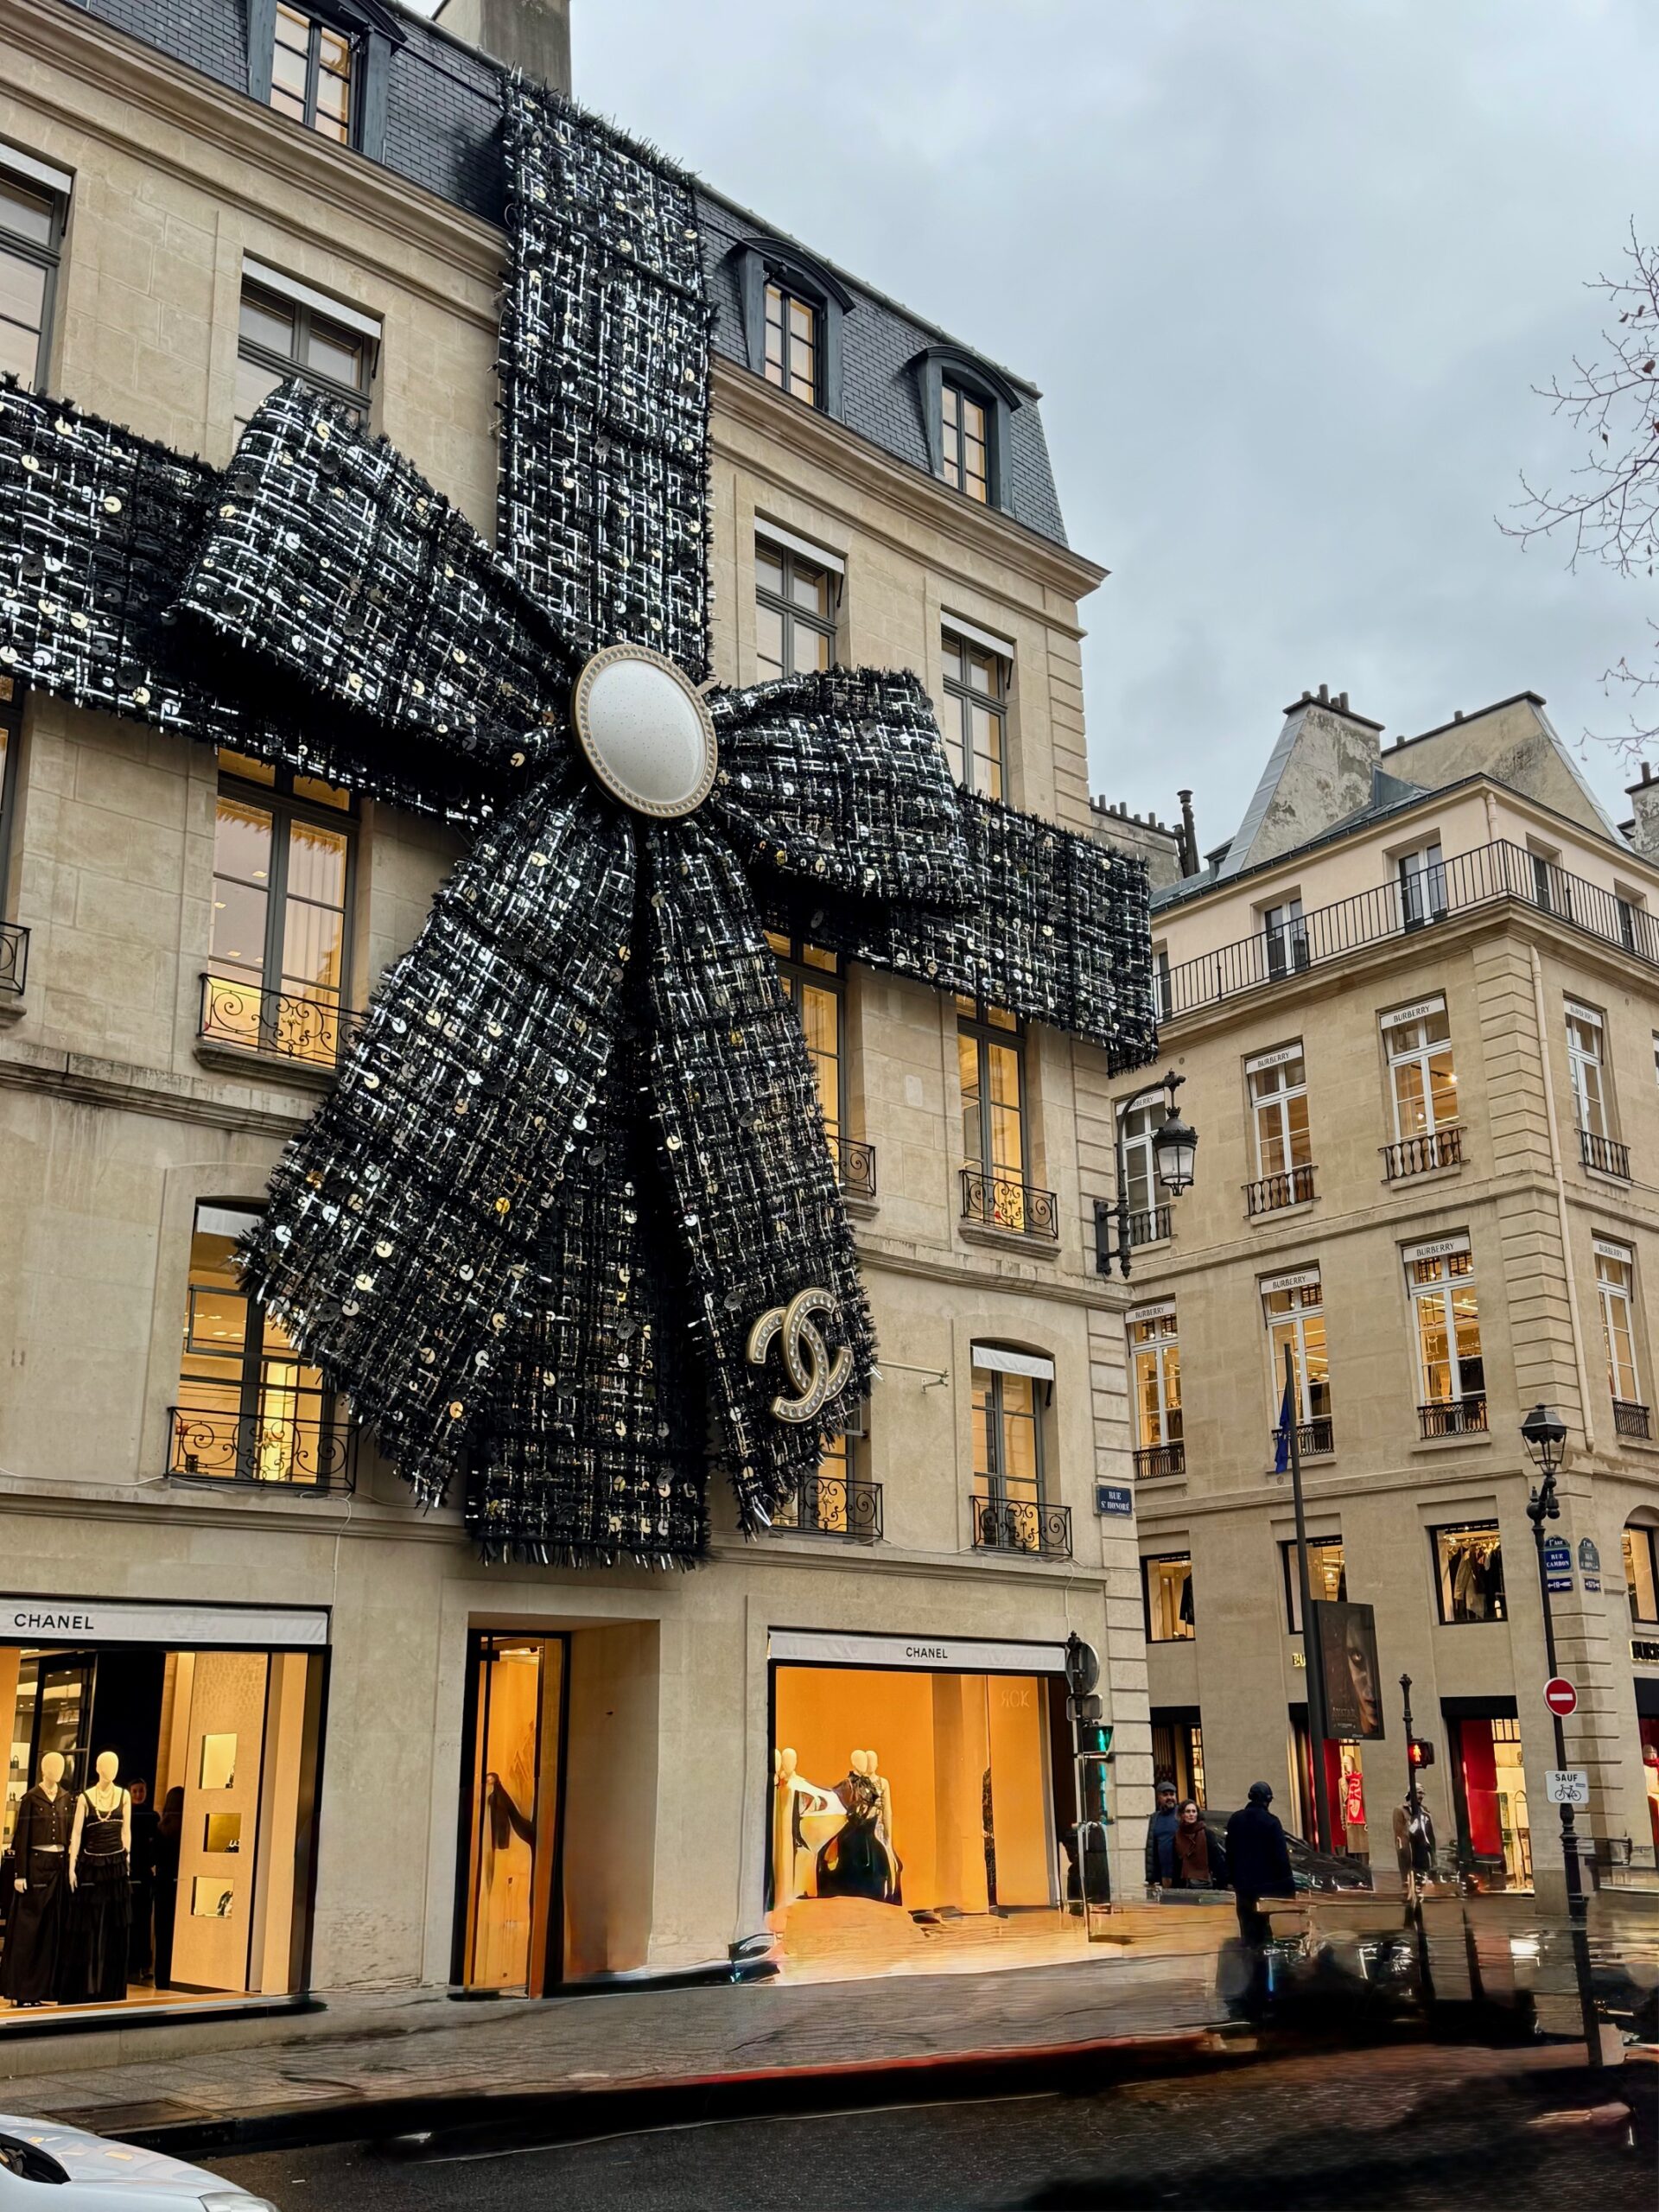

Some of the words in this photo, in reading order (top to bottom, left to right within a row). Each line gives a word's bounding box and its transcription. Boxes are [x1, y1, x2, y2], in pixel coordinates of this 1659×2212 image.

[1393, 1004, 1430, 1022] BURBERRY
[1257, 1051, 1290, 1067] BURBERRY
[1416, 1242, 1454, 1257] BURBERRY
[1272, 1274, 1306, 1289] BURBERRY
[1135, 1306, 1165, 1319] BURBERRY
[1109, 1491, 1122, 1500] RUE
[1107, 1502, 1130, 1510] HONORÉ
[14, 1613, 94, 1630] CHANEL
[906, 1646, 949, 1659] CHANEL
[1554, 1773, 1579, 1782] SAUF
